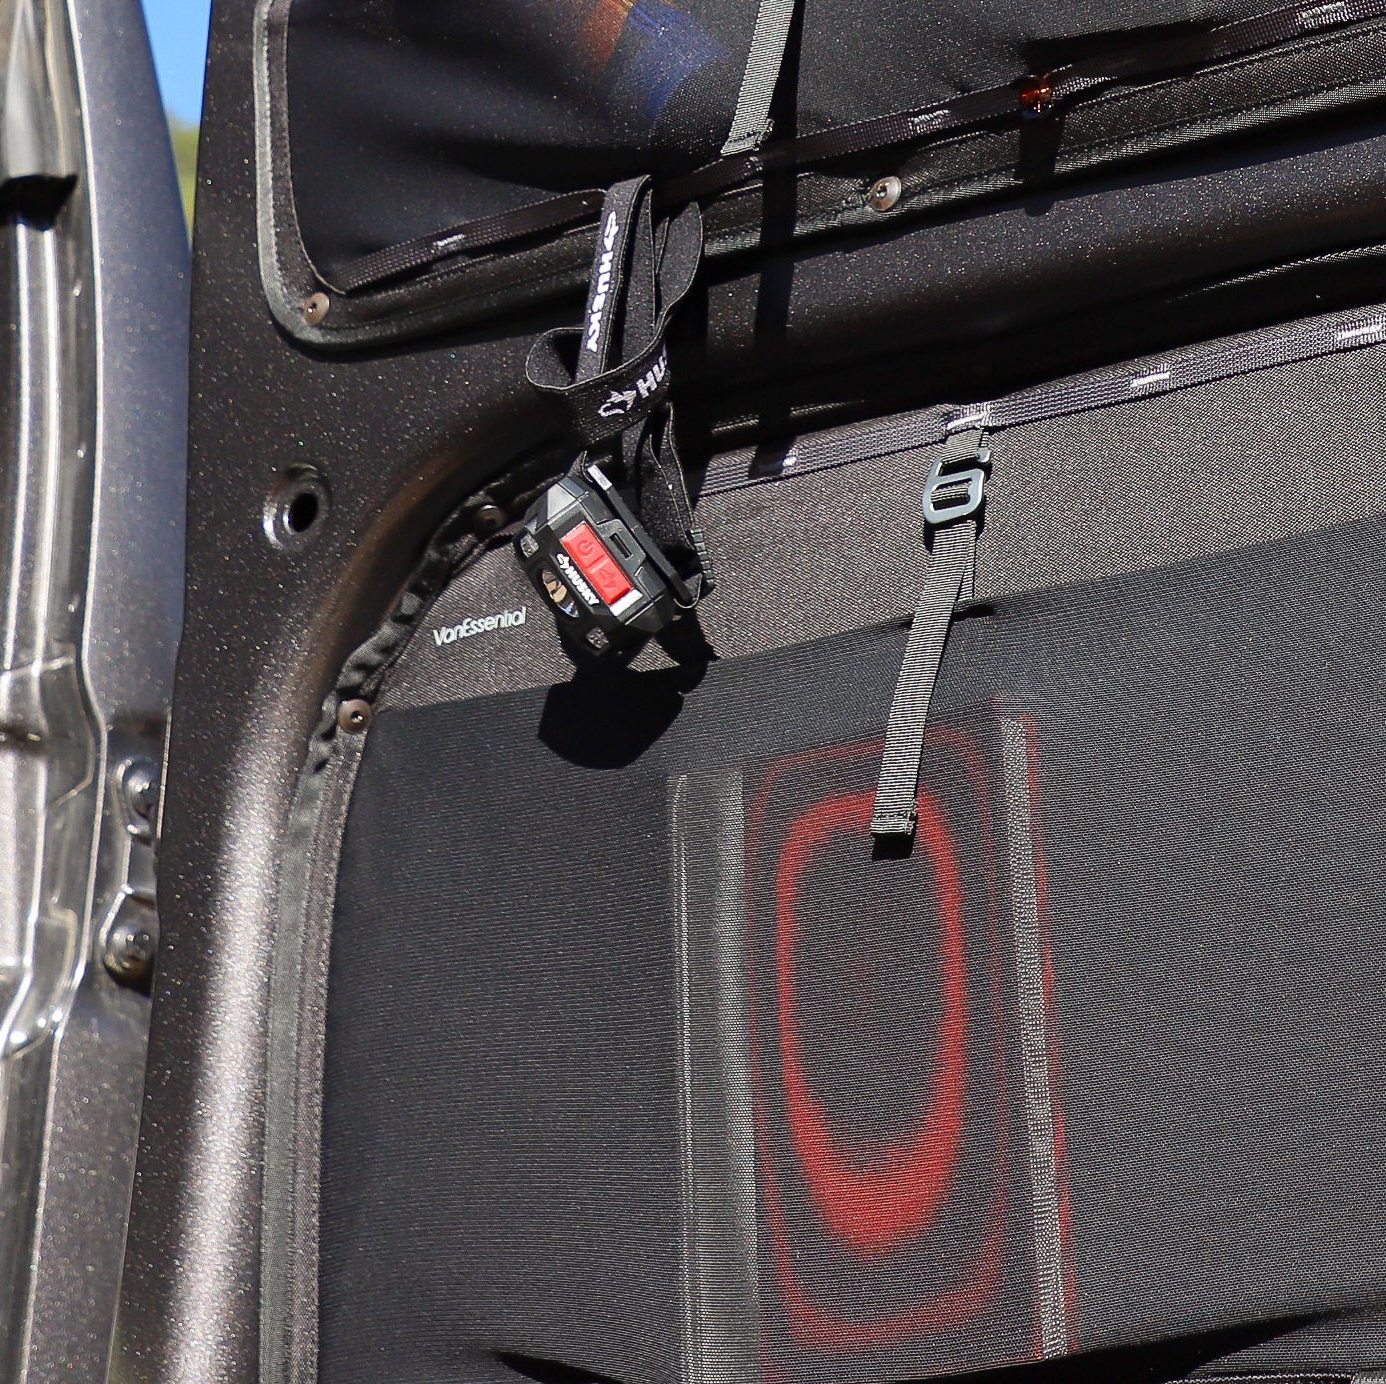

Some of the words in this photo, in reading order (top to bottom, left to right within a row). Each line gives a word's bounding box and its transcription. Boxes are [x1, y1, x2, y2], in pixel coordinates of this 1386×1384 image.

[587, 250, 614, 353] HUSKY
[564, 565, 600, 606] HUSKY
[433, 606, 527, 647] VanEssential
